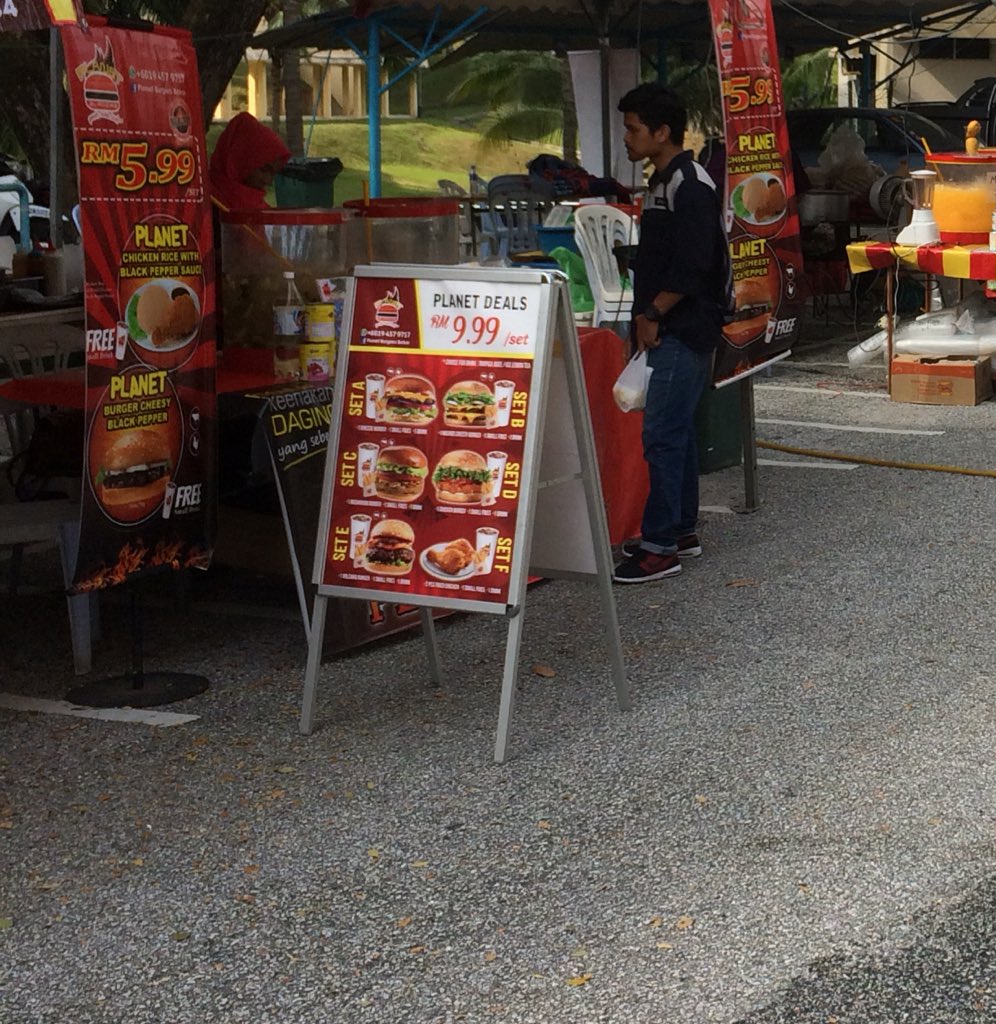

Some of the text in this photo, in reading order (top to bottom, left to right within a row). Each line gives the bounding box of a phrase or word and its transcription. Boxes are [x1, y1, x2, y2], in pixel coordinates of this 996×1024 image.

[739, 133, 776, 152] PLANET
[81, 142, 195, 190] RM 5.99
[135, 225, 188, 248] PLANET
[730, 239, 767, 259] LANET
[122, 251, 199, 263] CHICKEN RICE WITH
[120, 267, 148, 277] BLACK
[150, 266, 179, 276] PEPPER
[433, 293, 527, 310] PLANET DEALS
[431, 315, 529, 347] RM 9.99 /set
[776, 317, 797, 335] FREE
[86, 327, 116, 352] FREE
[110, 371, 167, 399] PLANET
[104, 397, 171, 416] BURGER CHEESY
[349, 380, 366, 416] SET A
[511, 391, 528, 428] SET B
[107, 412, 168, 430] BLACK PEPPER
[278, 439, 307, 462] yang
[341, 451, 357, 487] SET C
[502, 462, 520, 499] SET D
[175, 483, 202, 508] FREE
[333, 526, 350, 561] SET E
[495, 537, 512, 573] SET F
